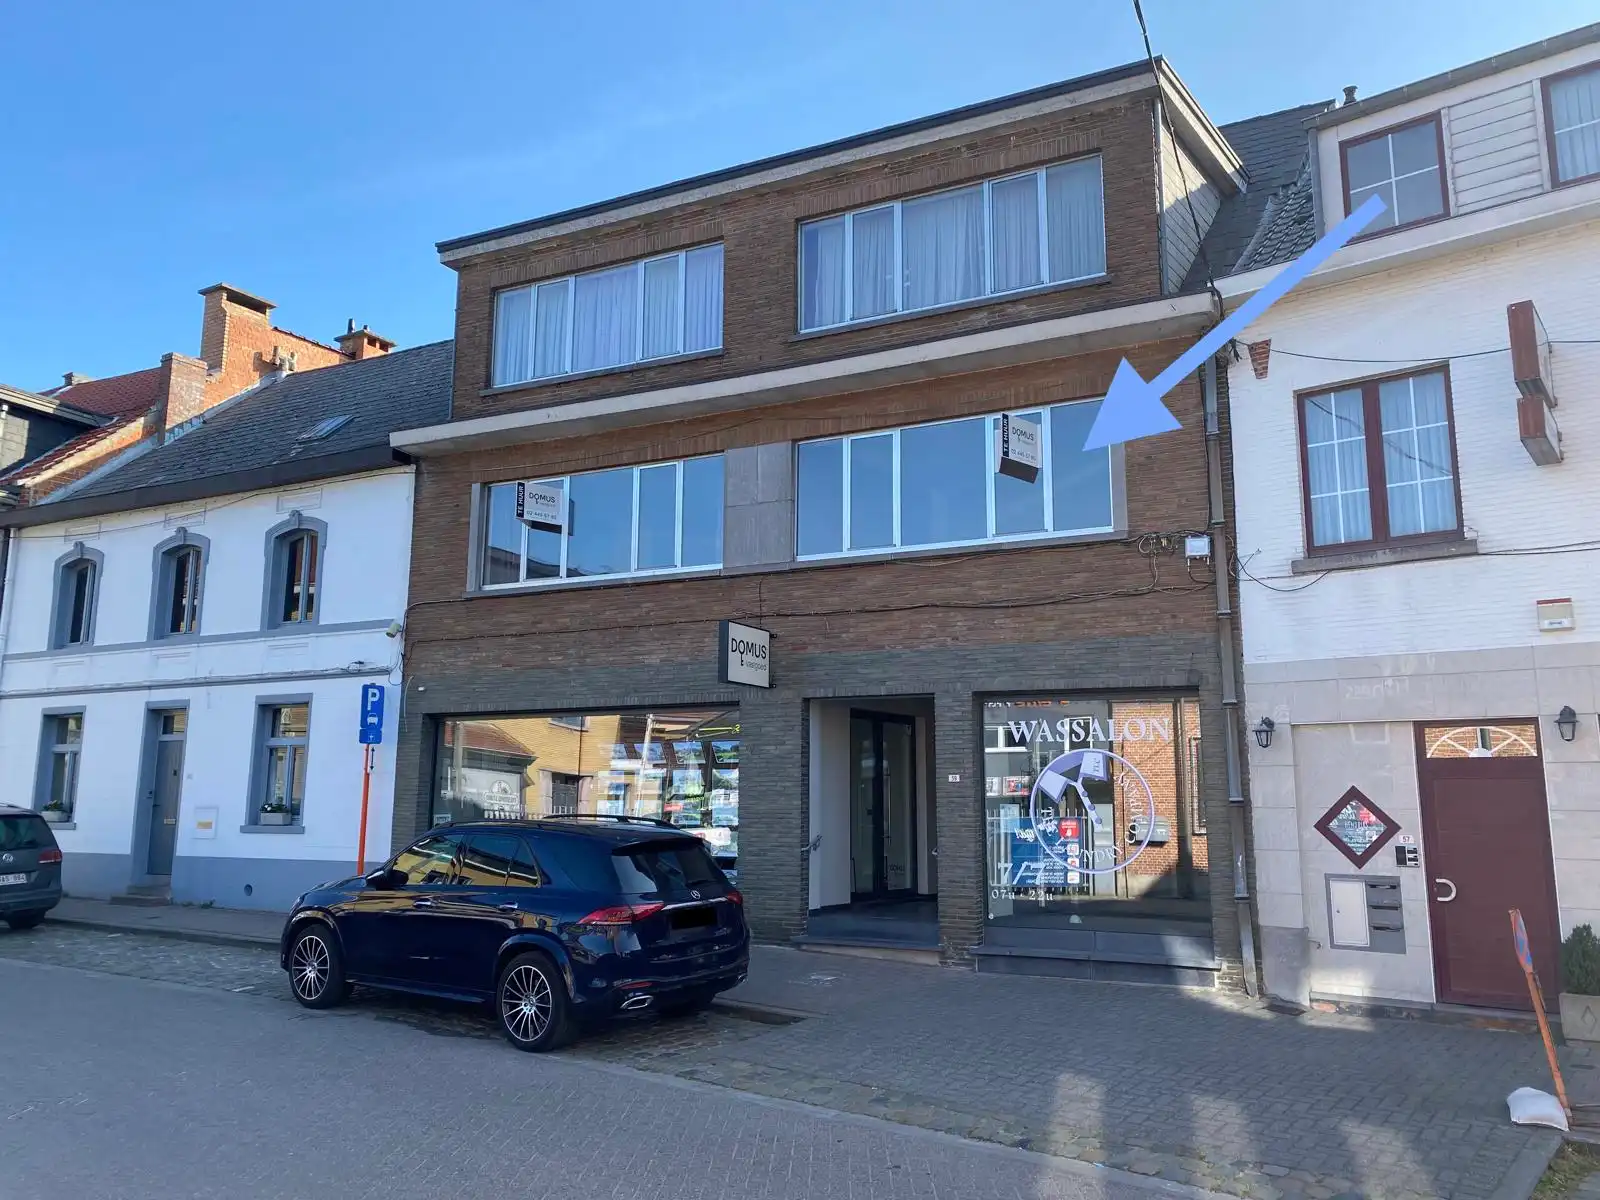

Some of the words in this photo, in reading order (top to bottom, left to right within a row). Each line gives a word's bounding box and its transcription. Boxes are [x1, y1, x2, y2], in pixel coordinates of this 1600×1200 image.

[1012, 426, 1035, 442] DOMUS
[1003, 440, 1009, 453] TE
[529, 492, 556, 504] DOMUS
[517, 505, 523, 515] TE
[731, 637, 767, 662] DOMUS
[367, 688, 380, 711] P
[1008, 719, 1170, 744] WASSALON
[997, 861, 1046, 886] 7/7
[991, 889, 1015, 900] 07u
[1028, 889, 1054, 901] 22u
